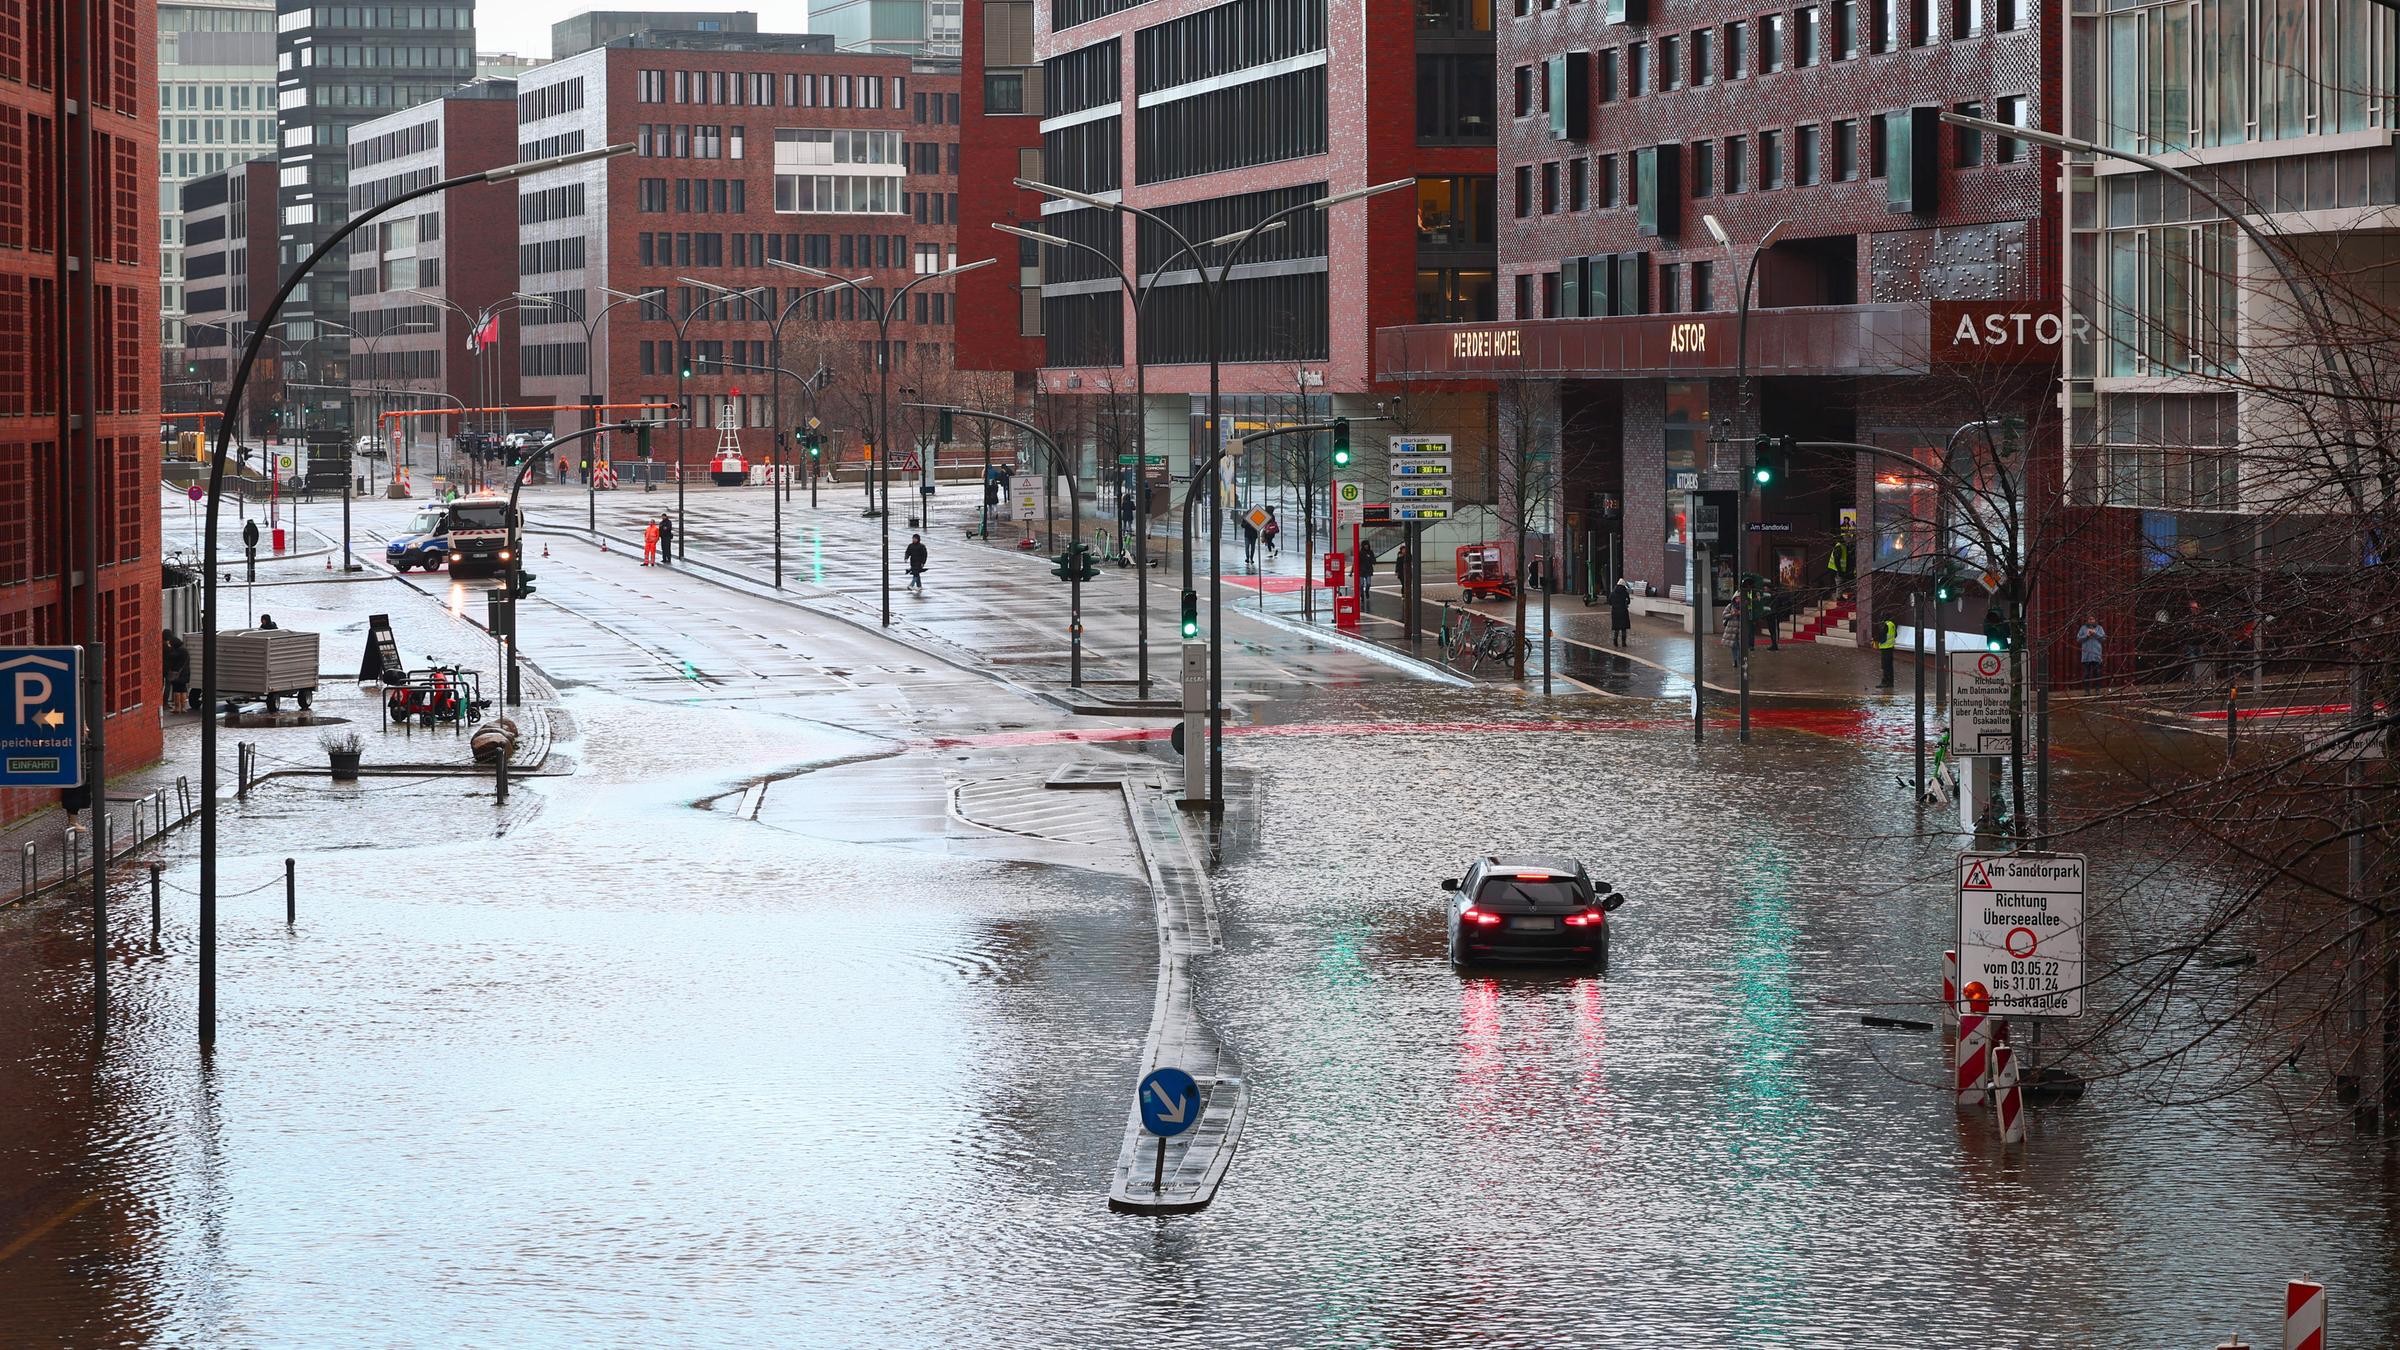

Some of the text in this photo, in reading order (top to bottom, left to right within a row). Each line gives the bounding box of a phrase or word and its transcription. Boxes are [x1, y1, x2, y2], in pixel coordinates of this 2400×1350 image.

[1952, 313, 2091, 346] ASTOR
[1453, 329, 1521, 358] PIERDREI HOTEL
[1670, 323, 1706, 353] ASTOR
[1676, 472, 1699, 491] KITCHENS
[1749, 522, 1790, 531] Am Sandtorkai
[1975, 677, 2005, 686] Richtung
[15, 672, 52, 725] P
[1957, 687, 1969, 695] Am
[1953, 698, 1983, 708] Richtung
[1955, 708, 1972, 716] über
[1973, 708, 1984, 716] Am
[1973, 717, 2010, 725] Osakaallee
[0, 737, 73, 750] peicherstadt
[12, 760, 56, 769] EINFAHRT
[1987, 863, 2080, 881] Am Sandtorpark
[1996, 893, 2047, 911] Richtung
[1983, 908, 2060, 926] Überseeallee
[1983, 961, 2059, 976] vom 03.05.22
[1993, 976, 2059, 991] bis 31.01.24
[2003, 993, 2068, 1009] Osakaallee
